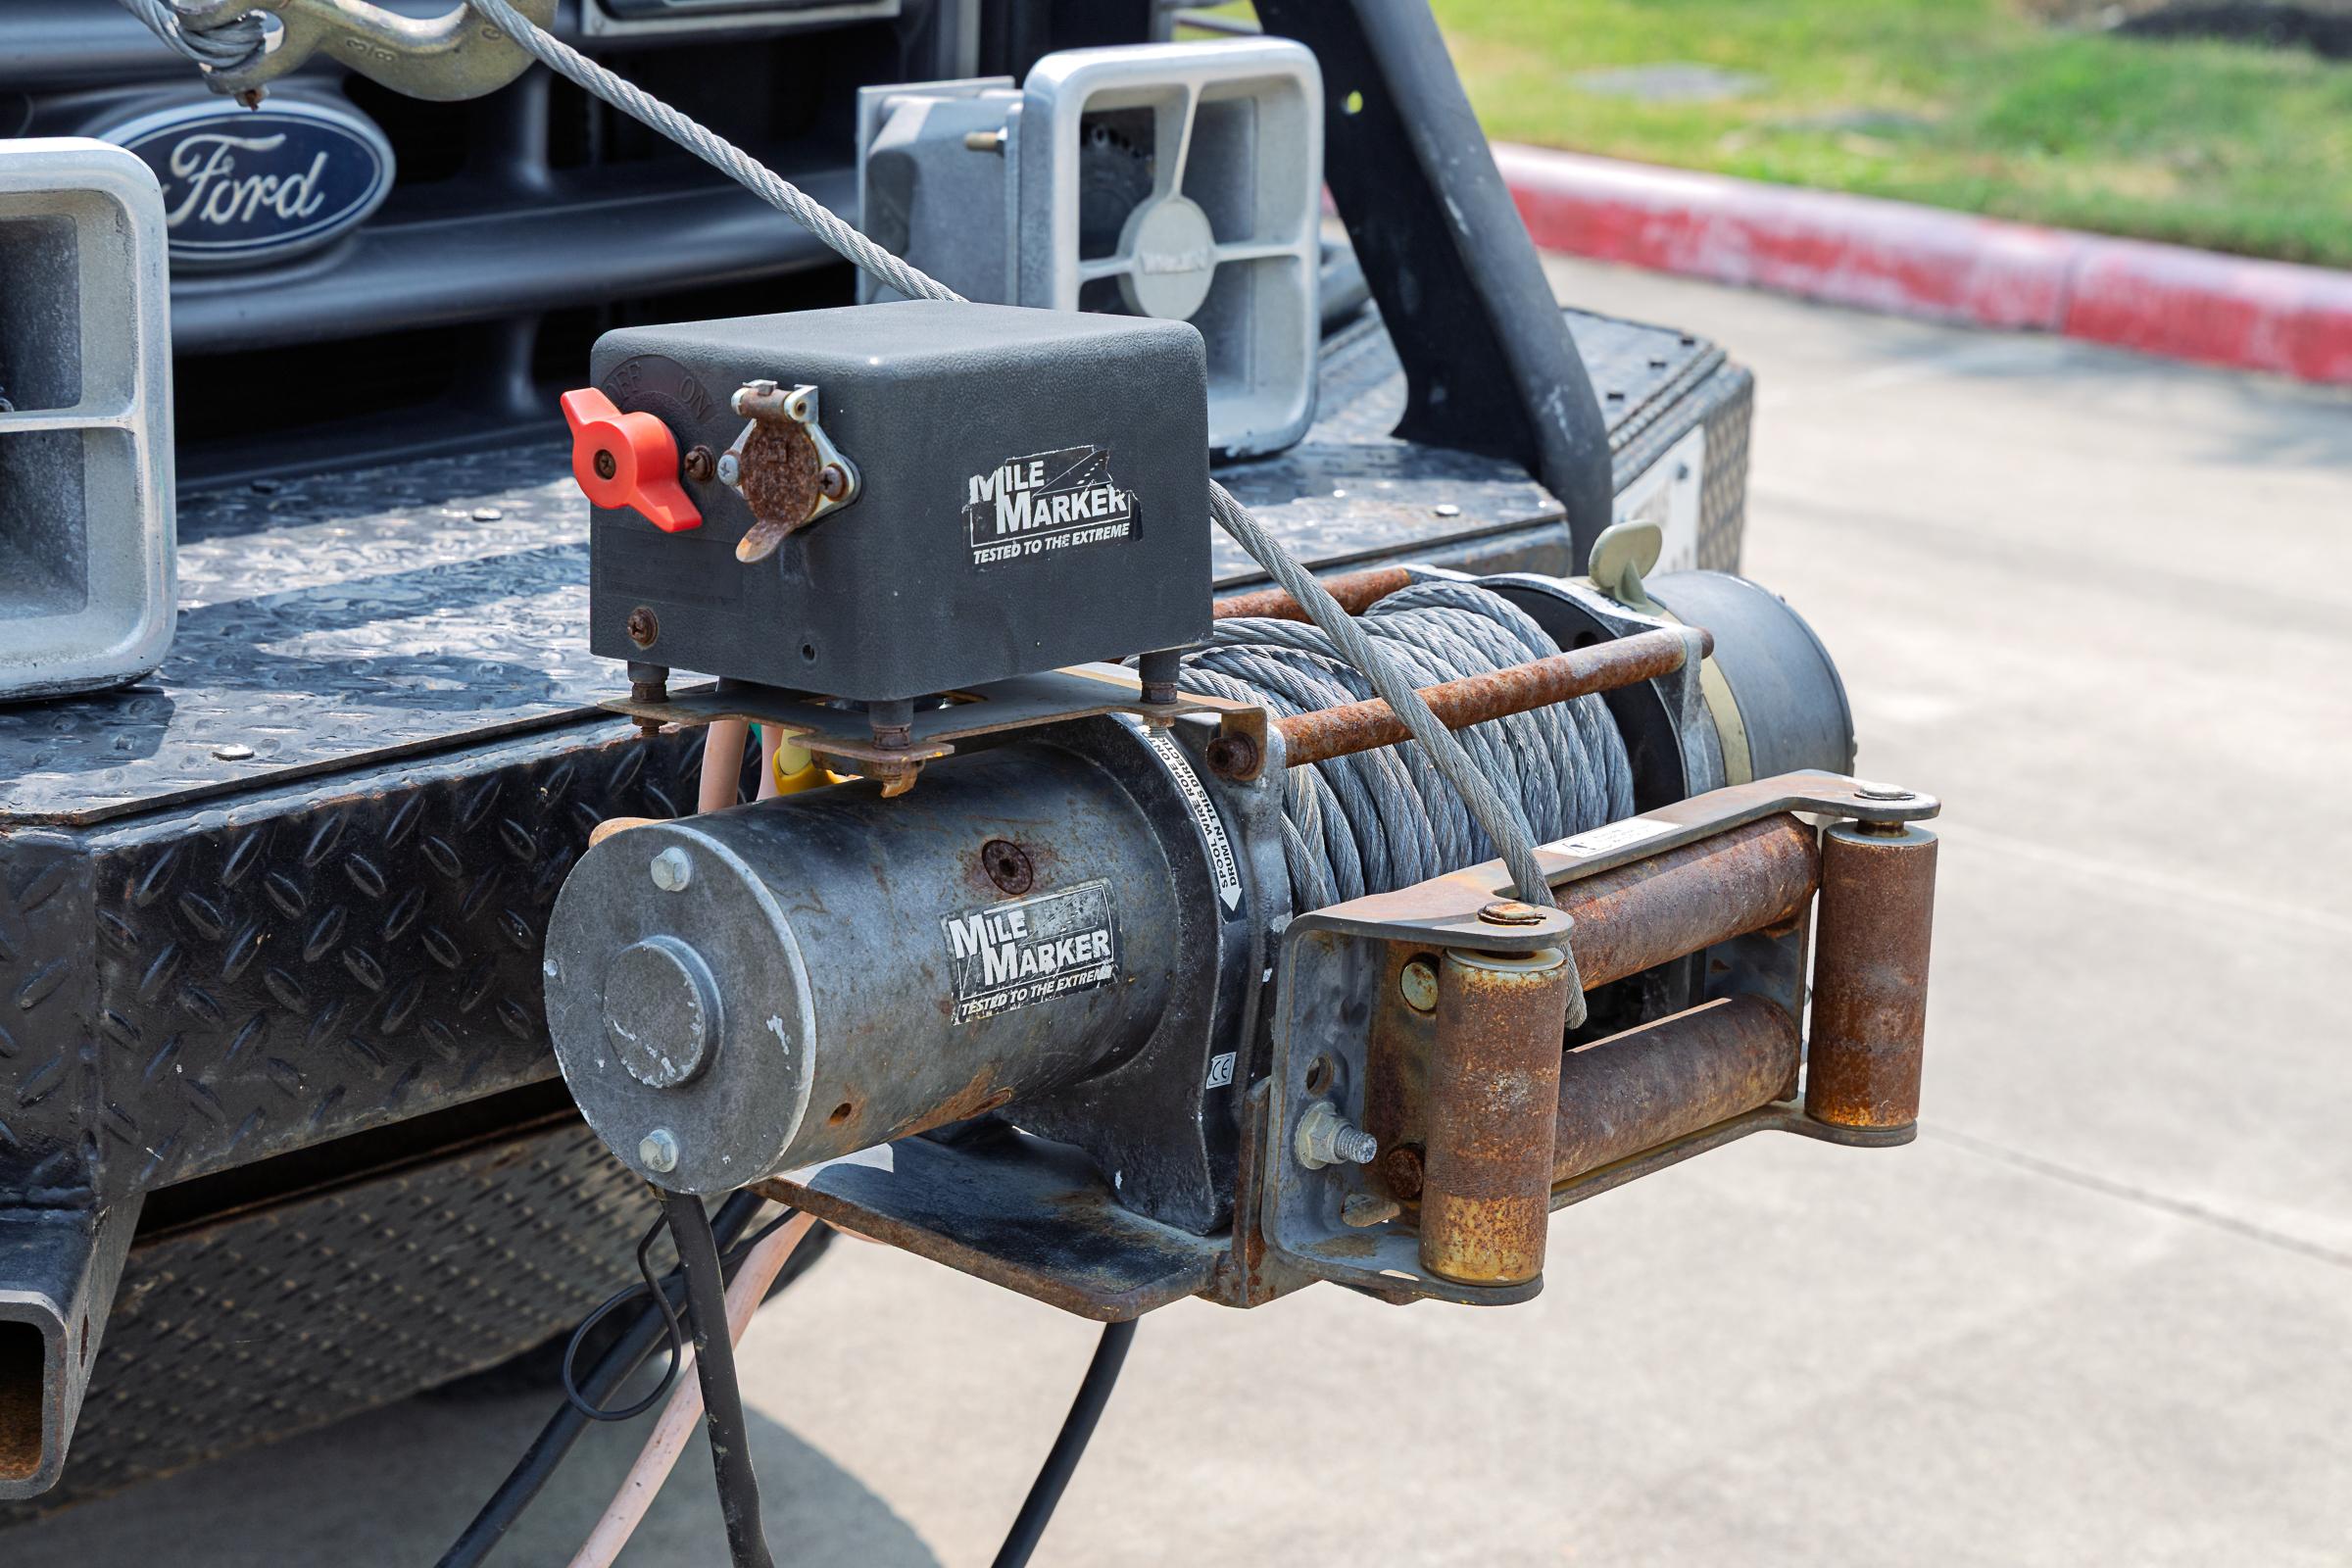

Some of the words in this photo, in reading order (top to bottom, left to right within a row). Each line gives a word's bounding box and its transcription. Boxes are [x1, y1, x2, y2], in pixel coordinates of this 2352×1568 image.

[162, 133, 328, 227] Ford
[606, 361, 642, 404] OFF
[679, 375, 713, 420] ON
[969, 460, 1045, 504] MILE
[996, 482, 1128, 534] MARKER
[973, 544, 1021, 564] TESTED
[1024, 540, 1043, 556] TO
[1045, 534, 1071, 550] THE
[1071, 522, 1130, 546] EXTREME
[1157, 737, 1200, 788] DIRECTIO
[1169, 763, 1195, 797] ROPE
[1192, 800, 1212, 836] WIRE
[1198, 790, 1216, 822] THIS
[1214, 826, 1225, 841] IN
[1211, 838, 1228, 889] SPOOL
[1221, 845, 1237, 886] DRUM
[948, 910, 1028, 958] MILE
[983, 929, 1111, 986] MARKER
[961, 991, 1007, 1016] TESTED
[1009, 988, 1028, 1003] TO
[1030, 980, 1055, 999] THE
[1056, 964, 1113, 991] EXTREM
[1212, 1058, 1230, 1081] CE
